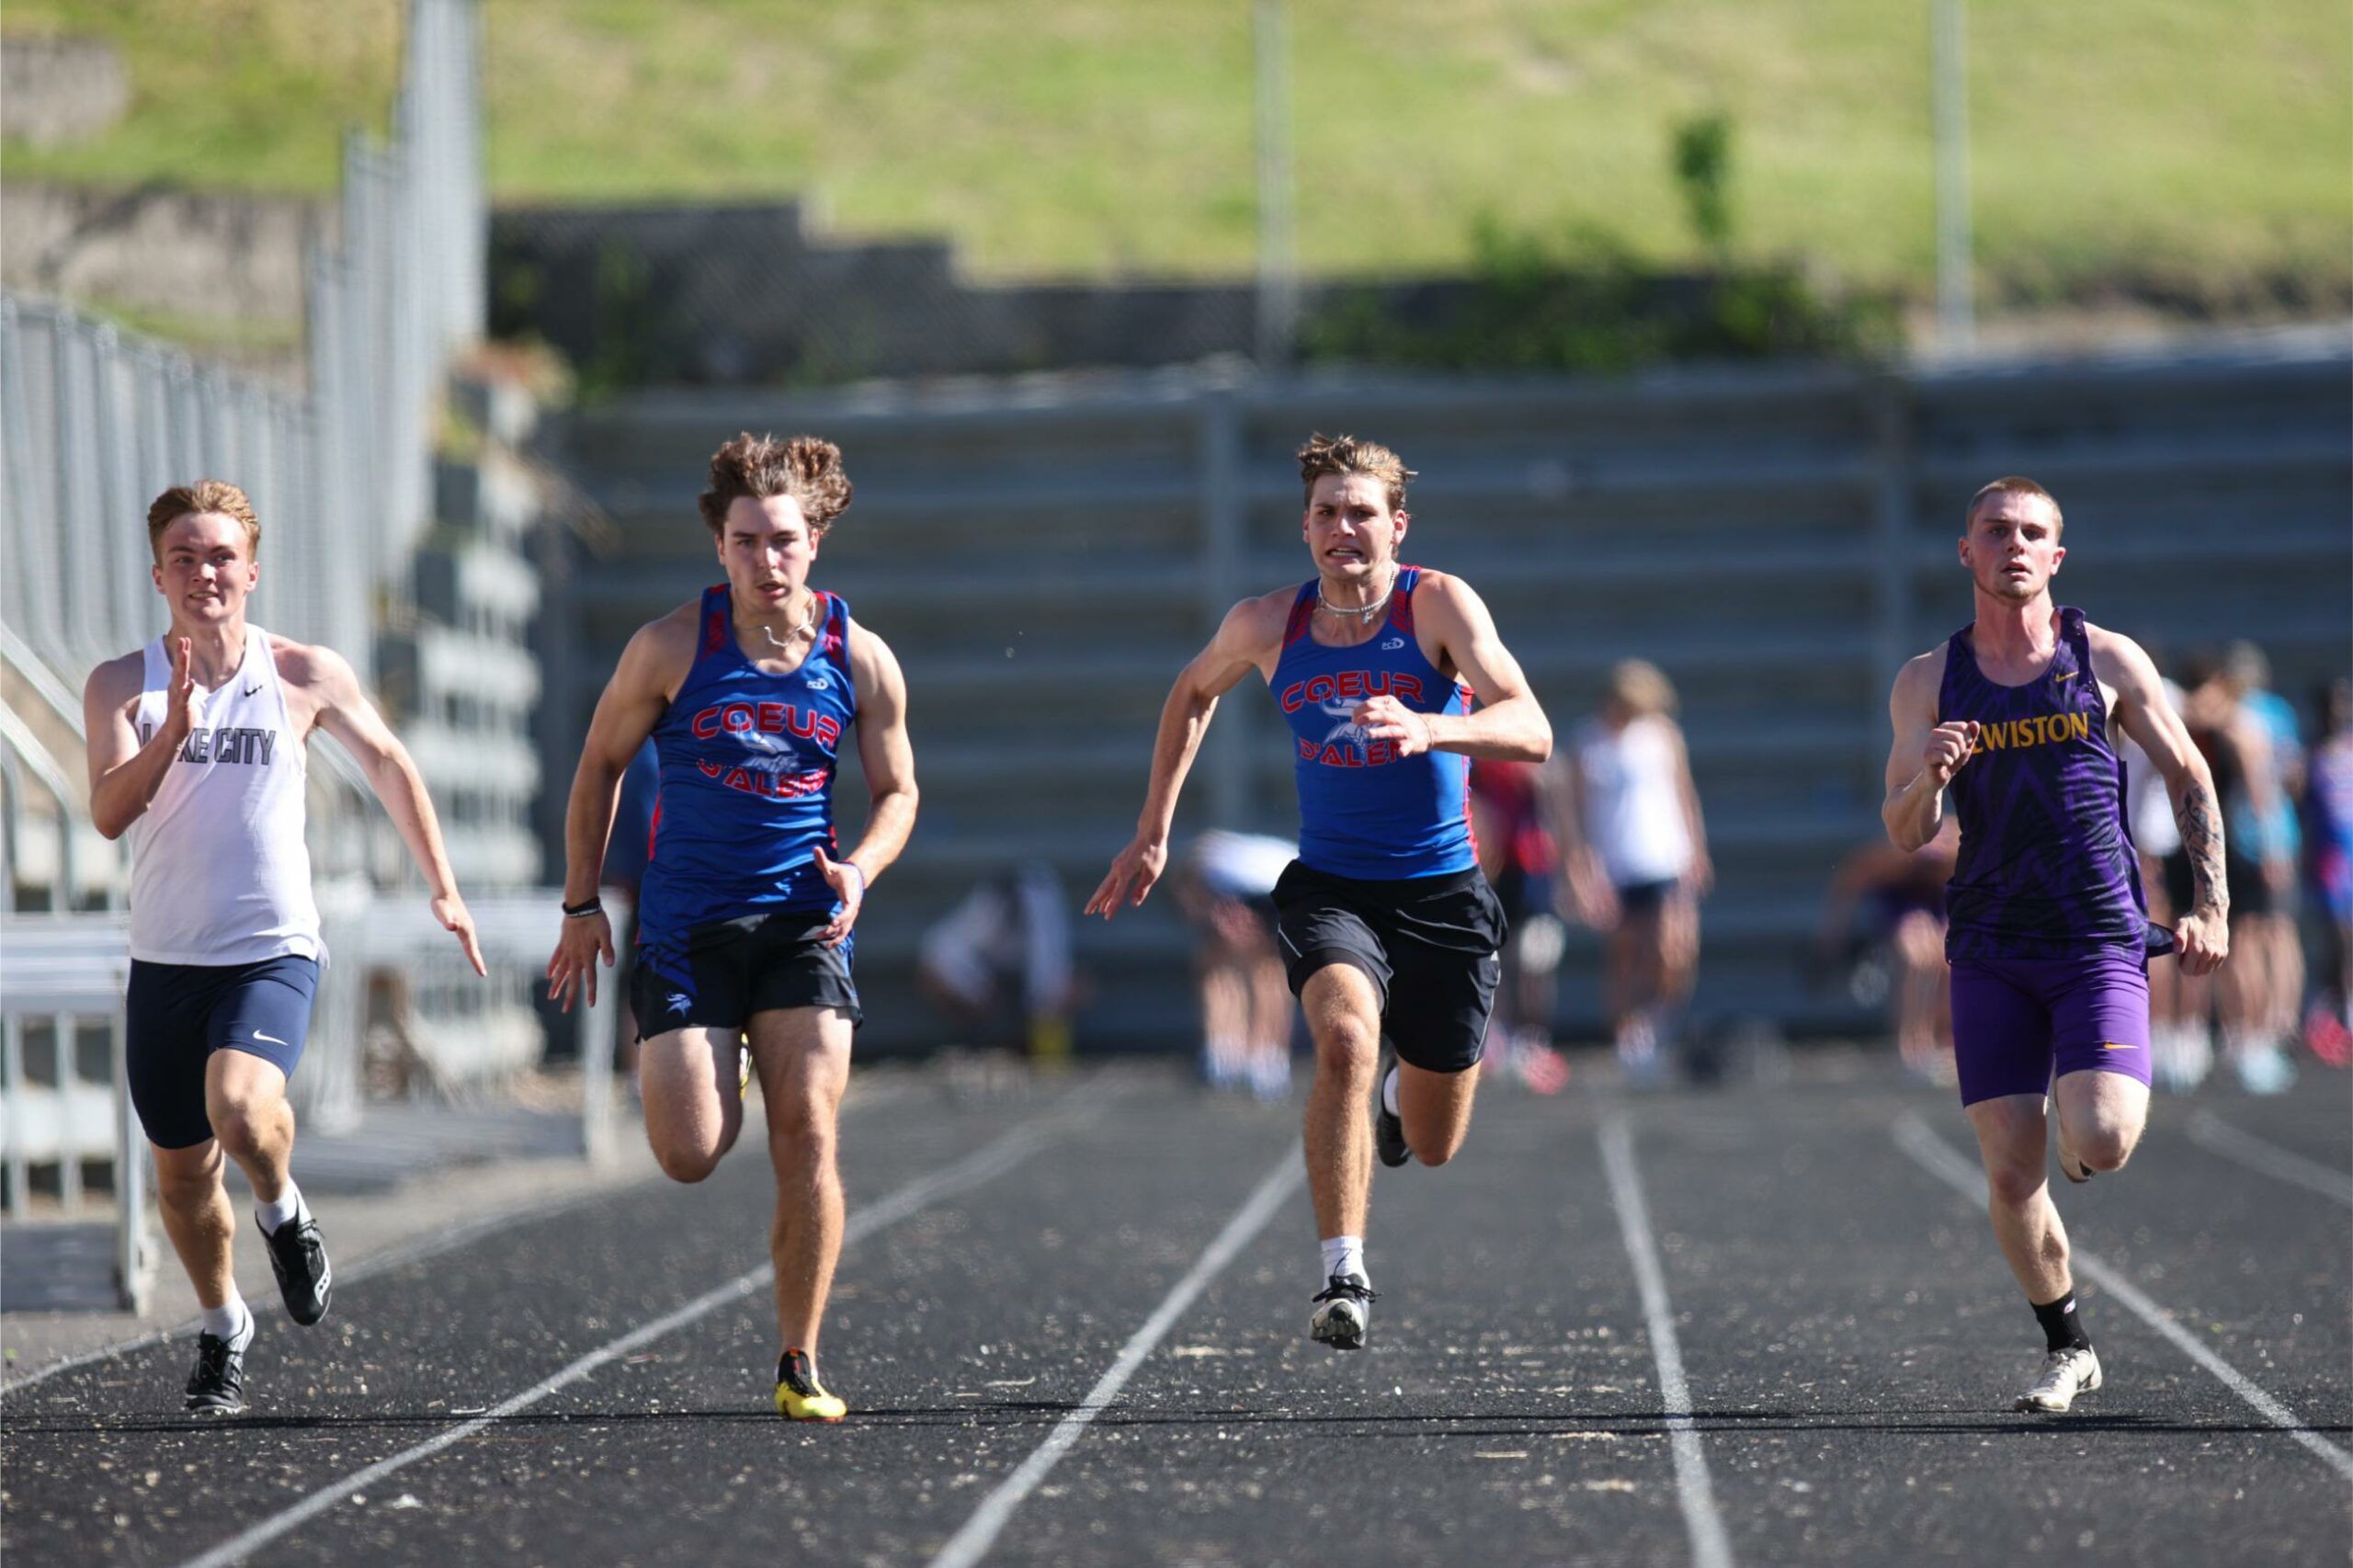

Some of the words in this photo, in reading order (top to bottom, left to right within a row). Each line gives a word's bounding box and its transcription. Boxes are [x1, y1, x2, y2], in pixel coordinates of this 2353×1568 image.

[1281, 670, 1424, 713] COEUR
[142, 722, 210, 763] LKE
[214, 727, 276, 766] CITY
[691, 702, 841, 748] COEUR
[1972, 711, 2088, 754] WISTON
